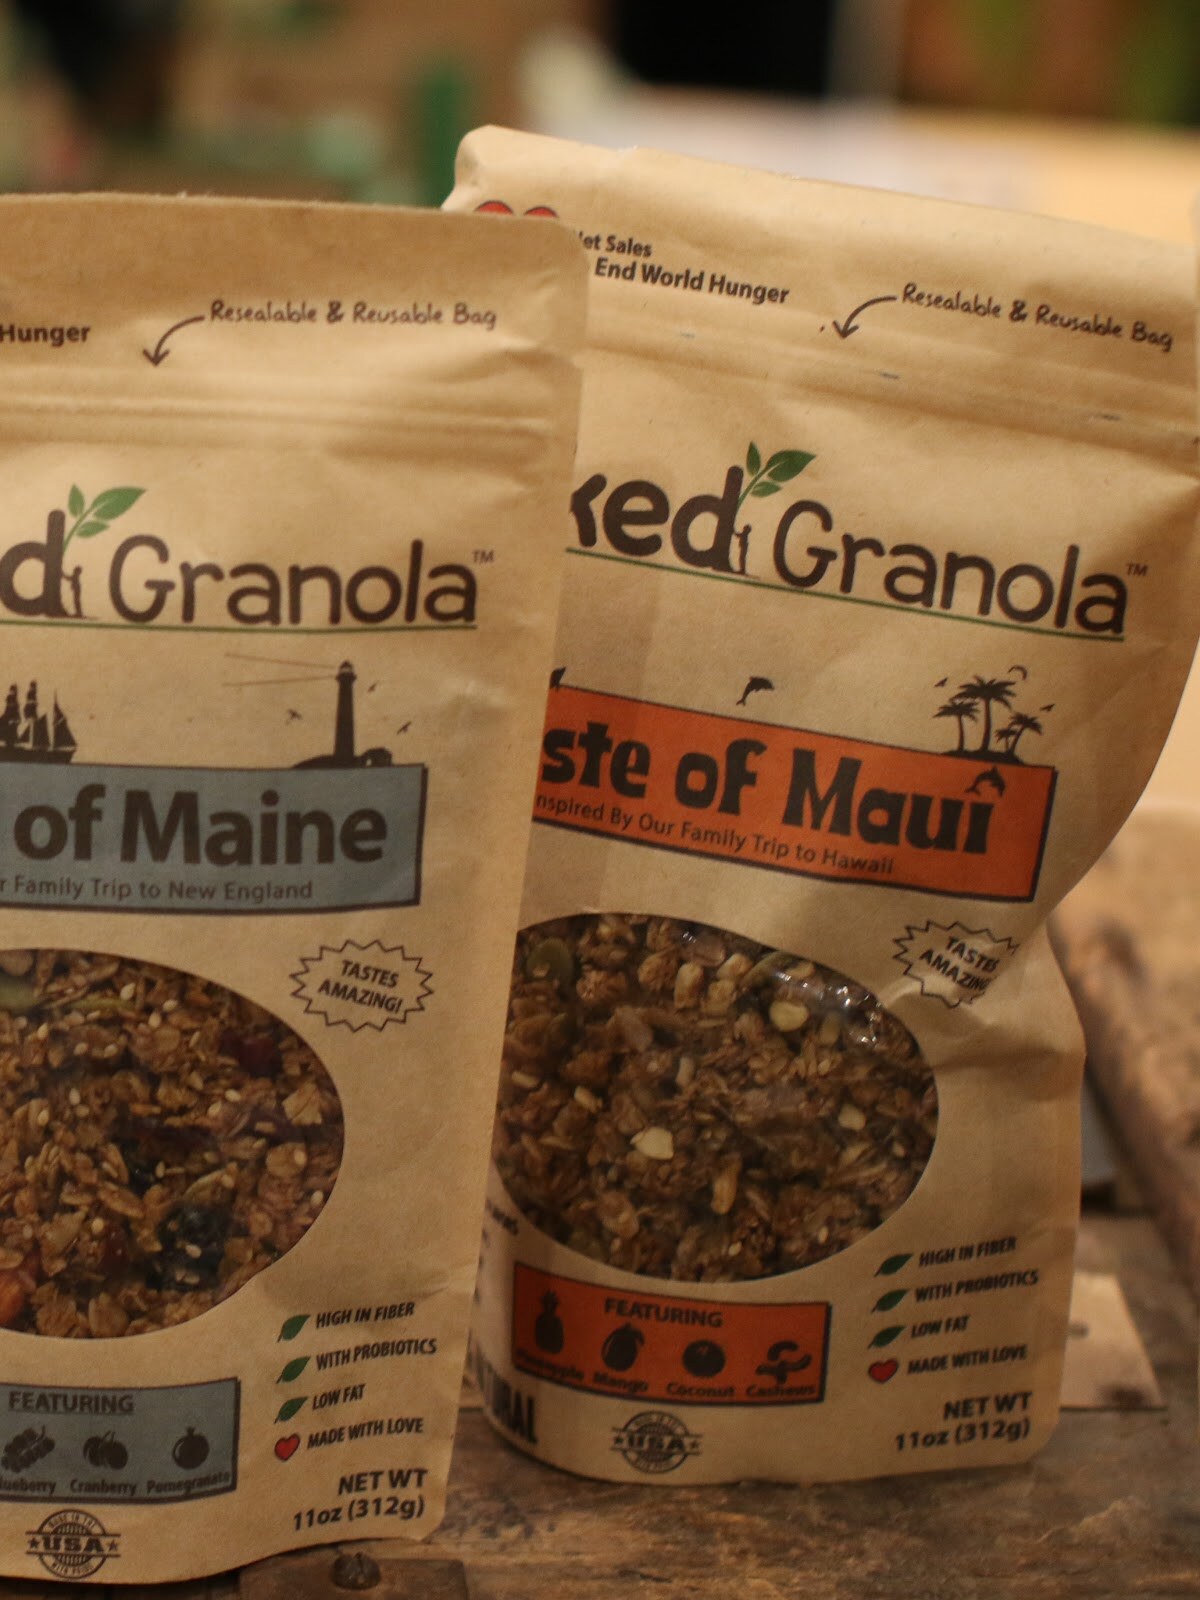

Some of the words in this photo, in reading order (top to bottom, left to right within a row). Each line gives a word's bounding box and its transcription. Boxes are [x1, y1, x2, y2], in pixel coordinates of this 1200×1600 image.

[605, 234, 653, 258] Sales
[594, 256, 636, 281] End
[641, 262, 705, 291] World
[708, 273, 791, 305] Hunger
[211, 300, 317, 324] Resealable
[327, 300, 345, 323] &
[353, 301, 443, 324] Reusable
[453, 301, 497, 331] Bag
[902, 282, 1001, 318] Resealable
[1008, 299, 1029, 323] &
[1035, 304, 1124, 338] Reusable
[1130, 320, 1174, 353] Bag
[773, 499, 1129, 634] Granola
[109, 540, 477, 625] Granola
[540, 721, 650, 799] ste
[674, 738, 767, 815] of
[782, 748, 1005, 854] Maui
[14, 782, 106, 862] of
[120, 788, 388, 867] Maine
[536, 793, 606, 821] nspired
[611, 803, 632, 830] By
[639, 812, 675, 837] Our
[681, 822, 747, 851] Family
[752, 833, 790, 860] Trip
[795, 842, 817, 864] to
[823, 848, 895, 875] Hawaii
[14, 874, 83, 899] Family
[91, 877, 131, 901] Trip
[139, 880, 161, 899] to
[168, 880, 217, 900] New
[224, 879, 314, 905] England
[340, 957, 399, 988] TASTES
[318, 977, 403, 1013] AMAZING!
[919, 1247, 955, 1267] HIGH
[958, 1243, 975, 1261] IN
[976, 1236, 1017, 1257] FIBER
[915, 1281, 952, 1303] WITH
[955, 1269, 1039, 1296] PROBIOTICS
[315, 1307, 351, 1329] HIGH
[355, 1307, 372, 1323] IN
[374, 1301, 416, 1322] FIBER
[604, 1297, 724, 1328] FEATURING
[911, 1320, 943, 1339] LOW
[945, 1314, 970, 1334] FAT
[316, 1349, 350, 1371] WITH
[353, 1338, 438, 1363] PROBIOTICS
[907, 1354, 948, 1375] MADE
[951, 1346, 990, 1369] WITH
[992, 1343, 1028, 1363] LOVE
[312, 1388, 340, 1411] LOW
[343, 1383, 366, 1401] FAT
[593, 1371, 649, 1395] Mango
[666, 1382, 735, 1398] Coconut
[746, 1382, 817, 1398] Cashews
[9, 1390, 135, 1413] FEATURING
[943, 1396, 990, 1421] NET
[994, 1390, 1033, 1414] WT
[307, 1426, 345, 1451] MADE
[348, 1420, 384, 1440] WITH
[387, 1417, 425, 1434] LOVE
[627, 1433, 685, 1451] USA
[895, 1429, 949, 1452] 11oz
[955, 1417, 1032, 1446] (312g)
[70, 1479, 138, 1497] Cranberry
[147, 1470, 231, 1496] Pomegranate
[338, 1470, 384, 1496] NET
[388, 1468, 429, 1489] WT
[293, 1505, 343, 1532] 11oz
[348, 1494, 426, 1522] (312g)
[42, 1535, 105, 1553] USA
